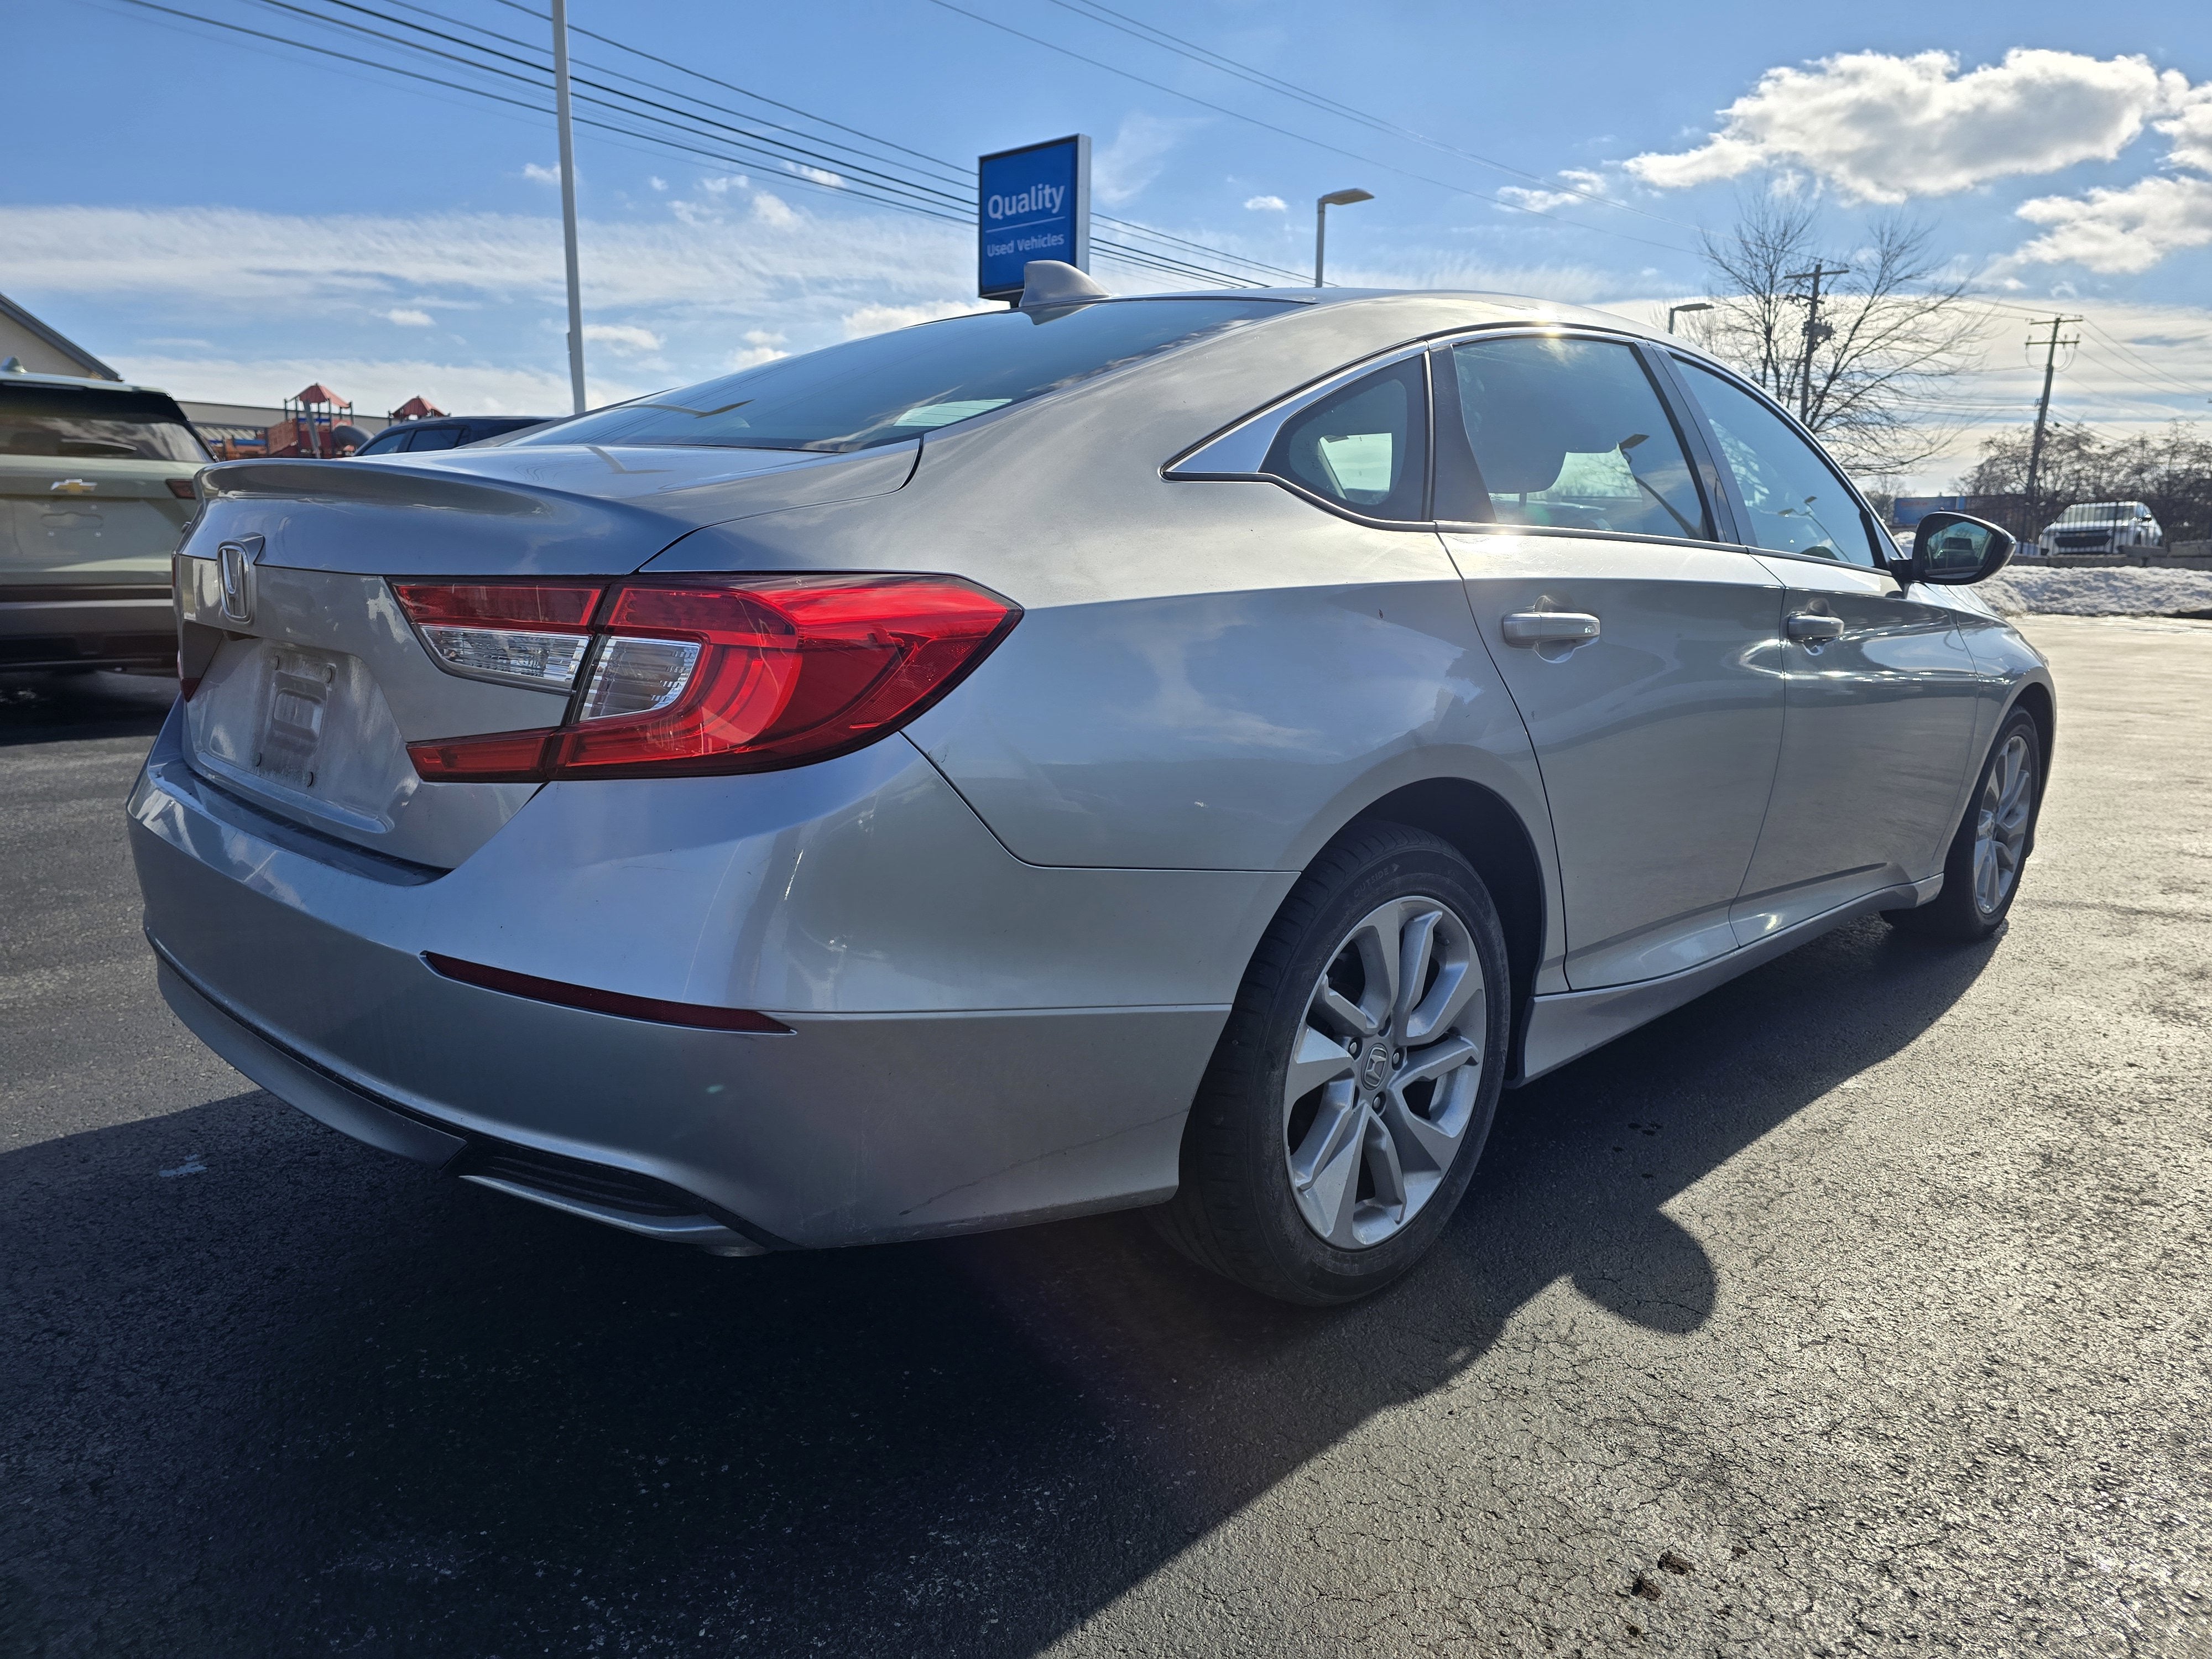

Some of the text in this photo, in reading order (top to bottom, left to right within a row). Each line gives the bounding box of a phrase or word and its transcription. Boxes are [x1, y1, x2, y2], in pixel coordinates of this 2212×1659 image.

[988, 184, 1065, 220] Quality
[987, 233, 1065, 257] Used Vehicles
[1354, 867, 1389, 898] OUTSIDE
